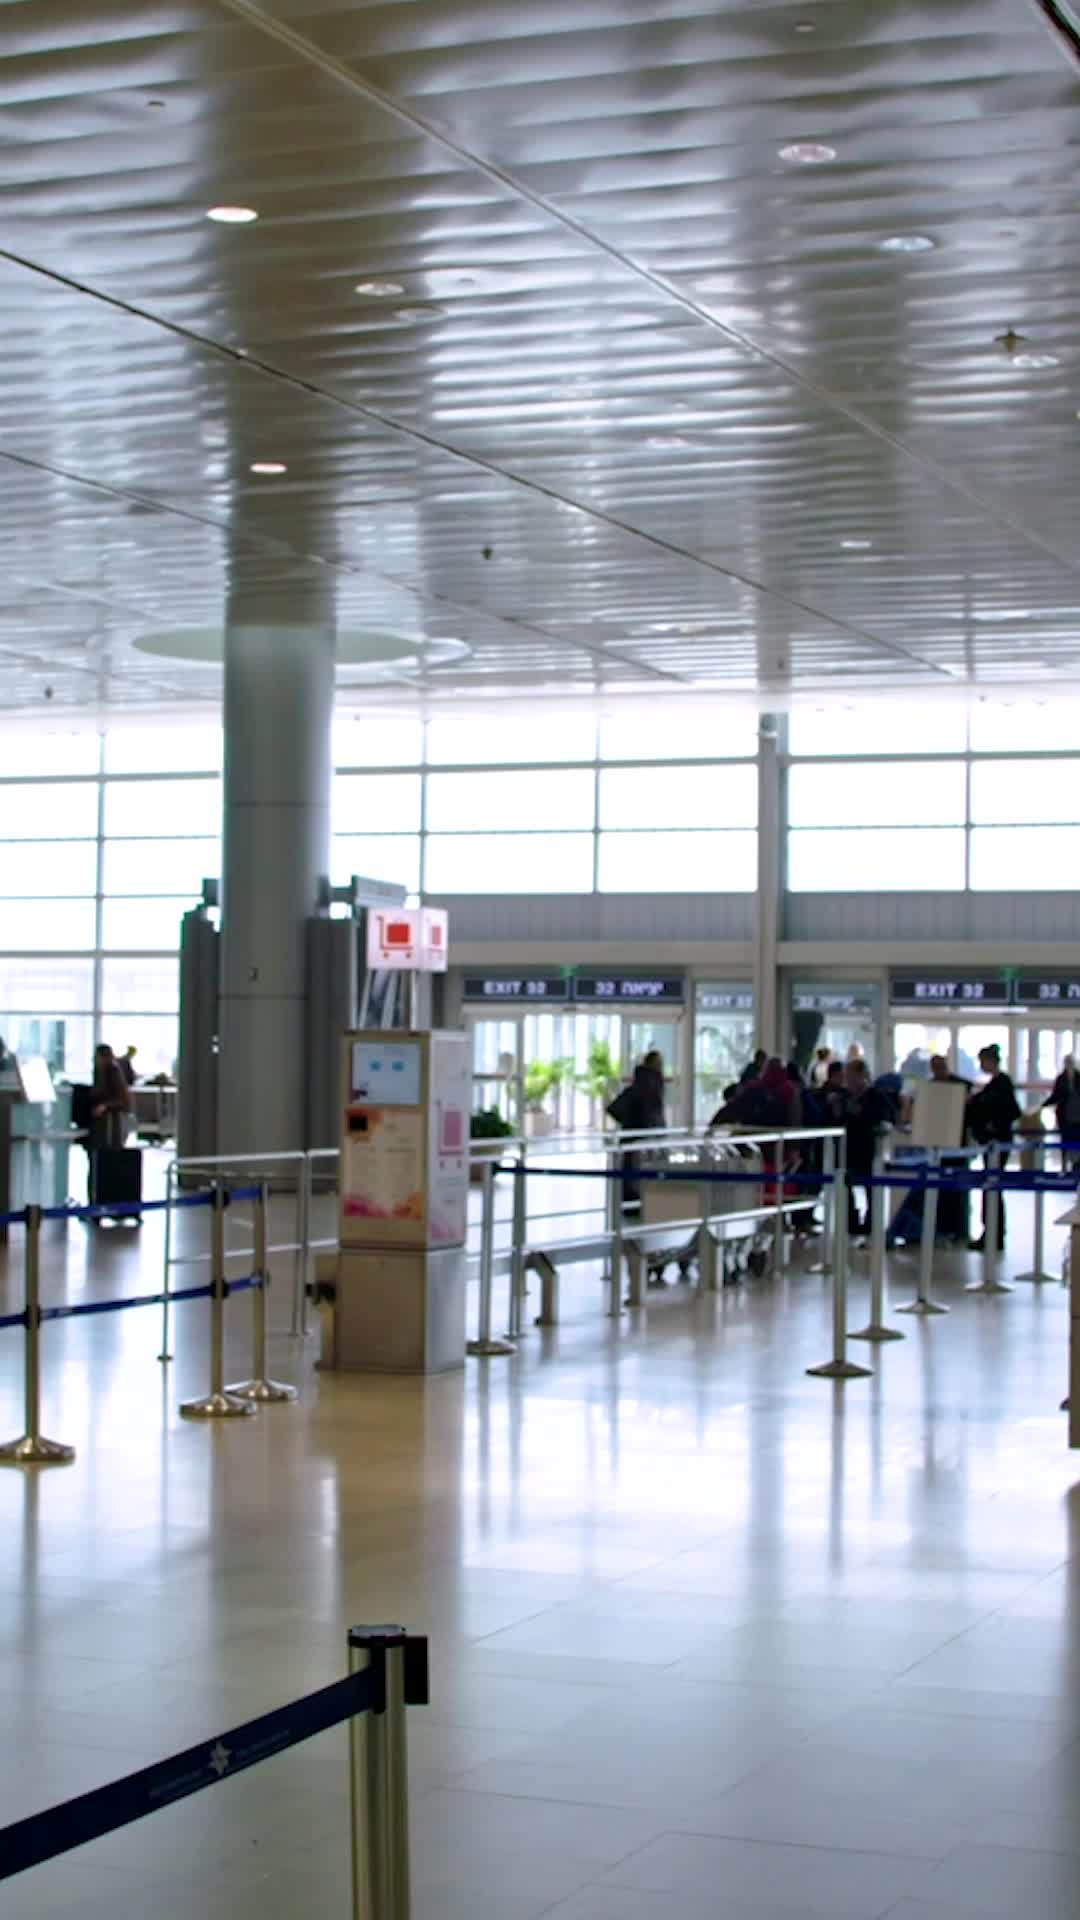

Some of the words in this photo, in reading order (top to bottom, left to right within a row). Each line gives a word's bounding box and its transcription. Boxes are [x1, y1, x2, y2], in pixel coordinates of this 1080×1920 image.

[484, 980, 521, 995] EXIT
[595, 981, 615, 996] 32
[914, 983, 957, 997] EXIT
[961, 983, 984, 997] 32
[1039, 984, 1060, 998] 32
